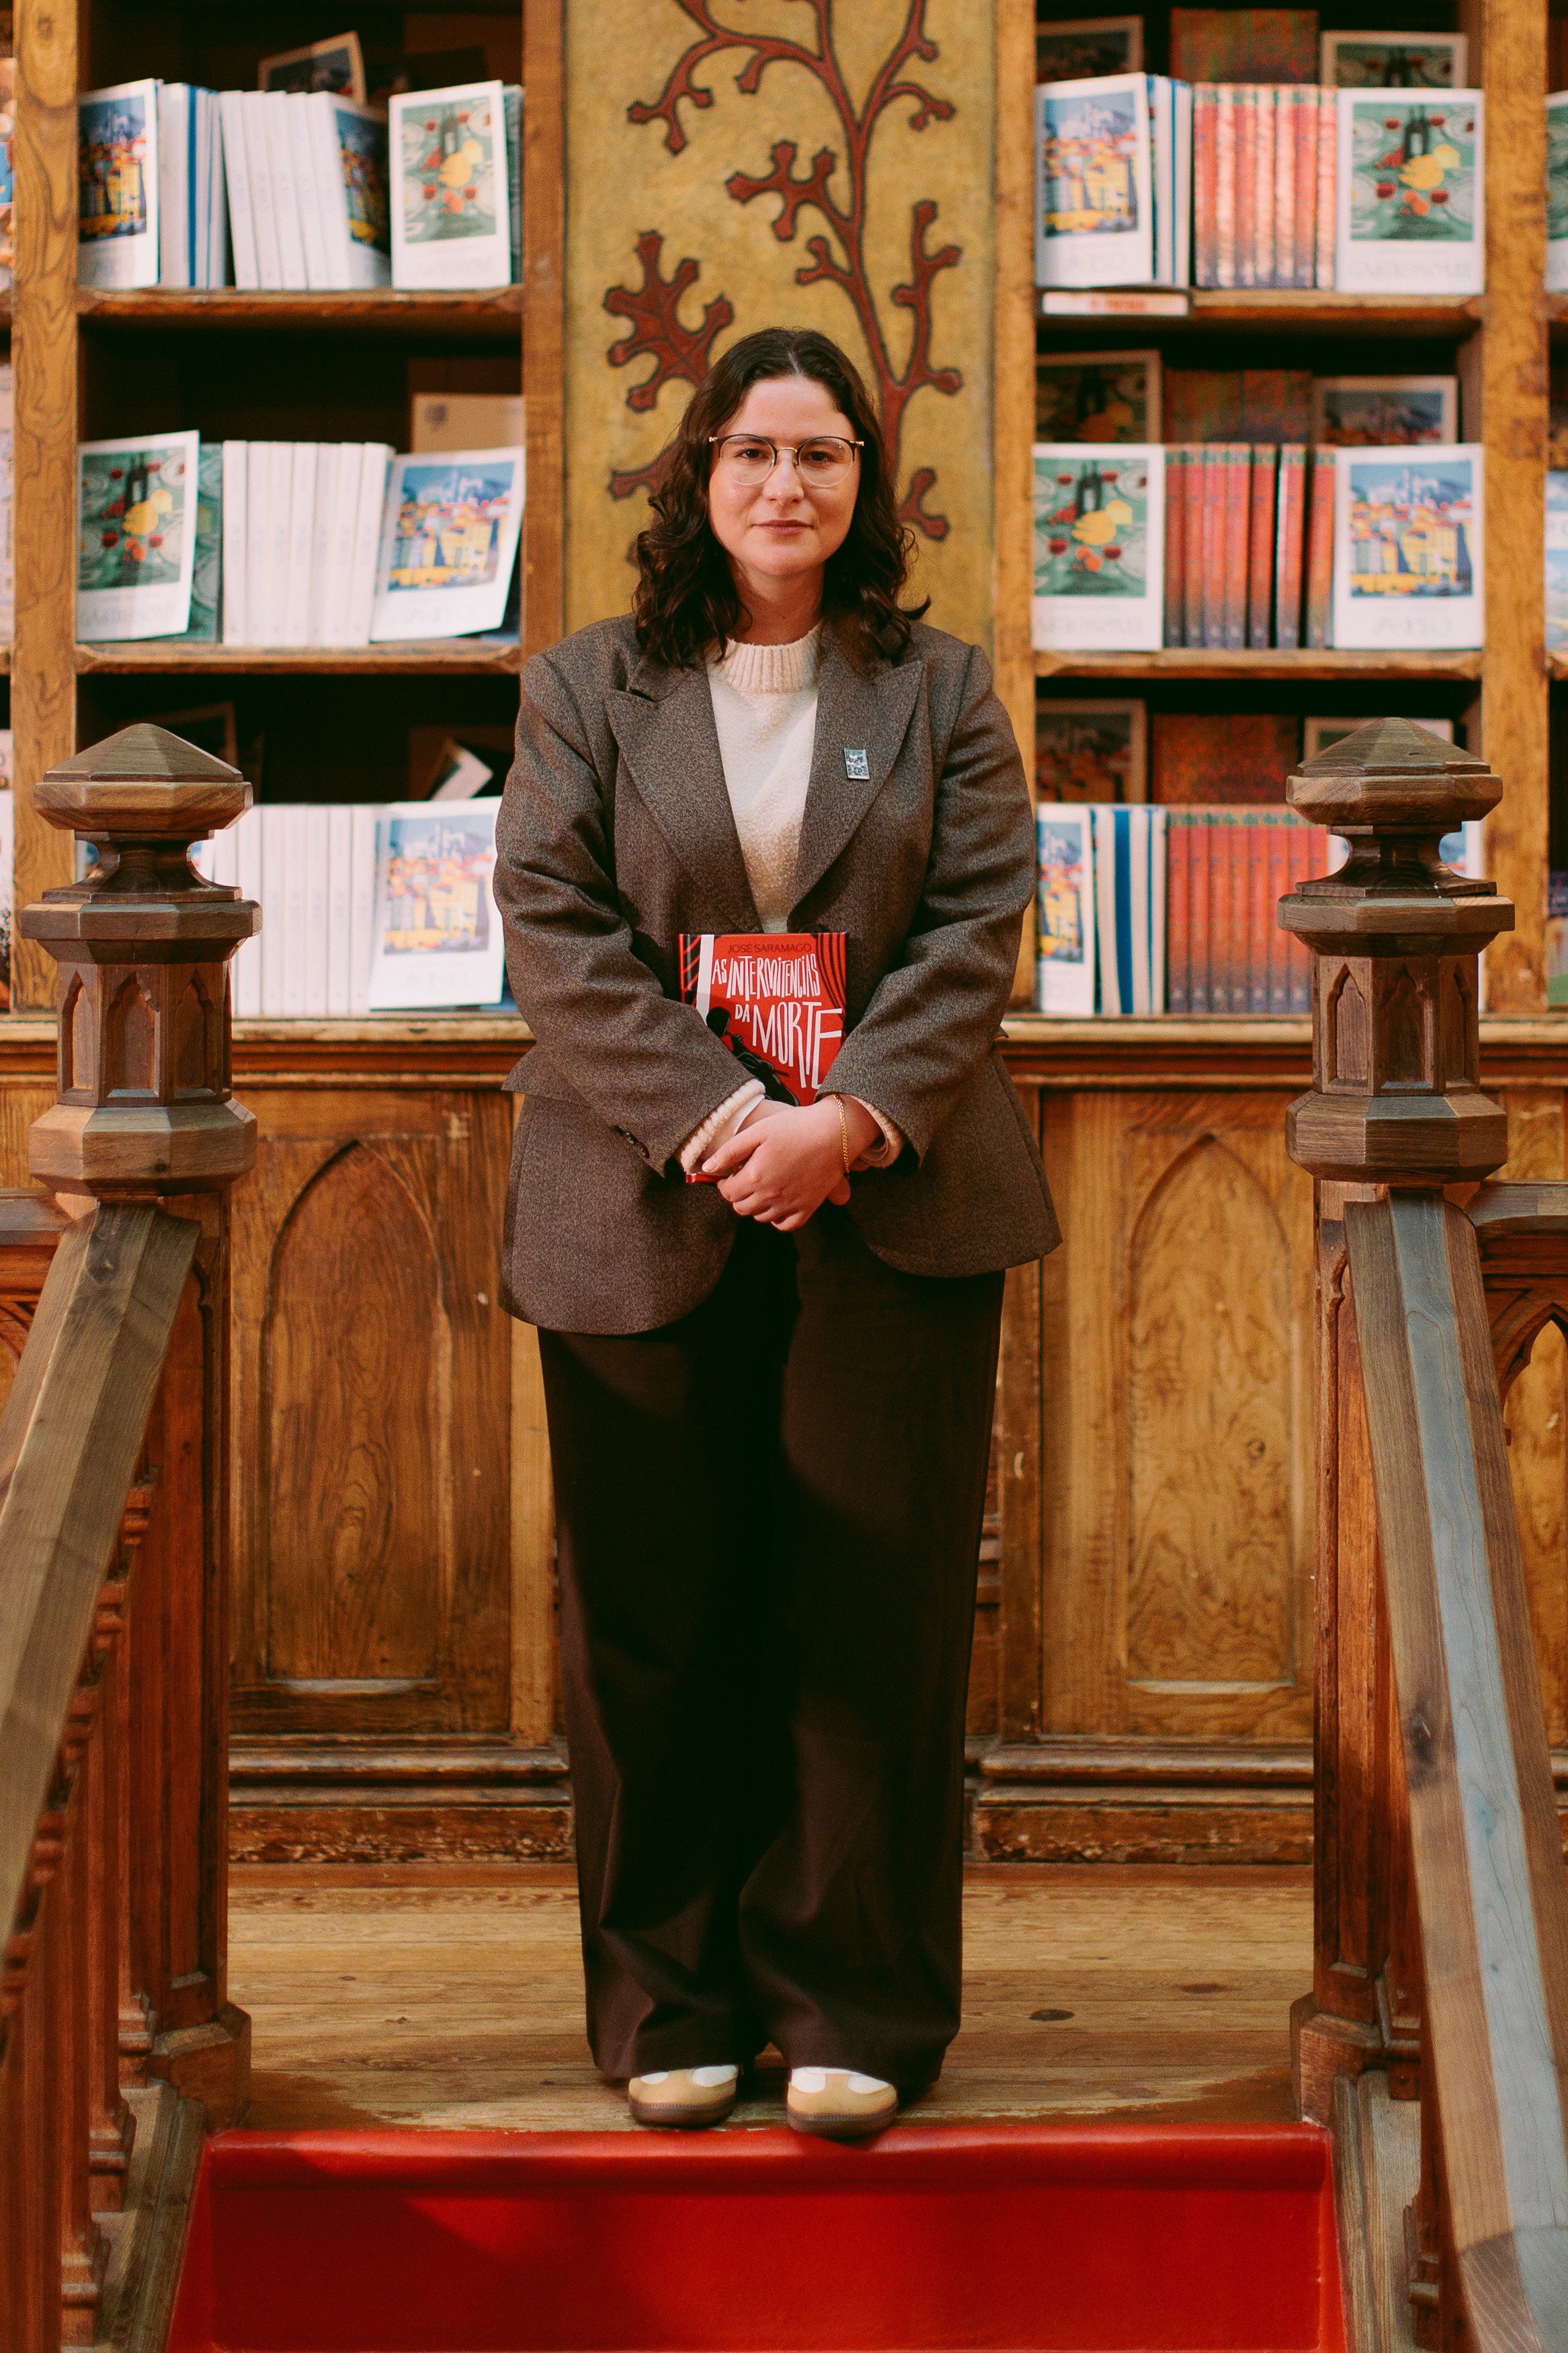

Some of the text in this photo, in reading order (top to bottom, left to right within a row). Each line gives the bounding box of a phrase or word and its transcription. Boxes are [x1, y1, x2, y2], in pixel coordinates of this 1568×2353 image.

[728, 941, 812, 953] JOSÉ SARAMAGO
[711, 958, 727, 985] AS
[735, 1001, 843, 1090] DA MORTE
